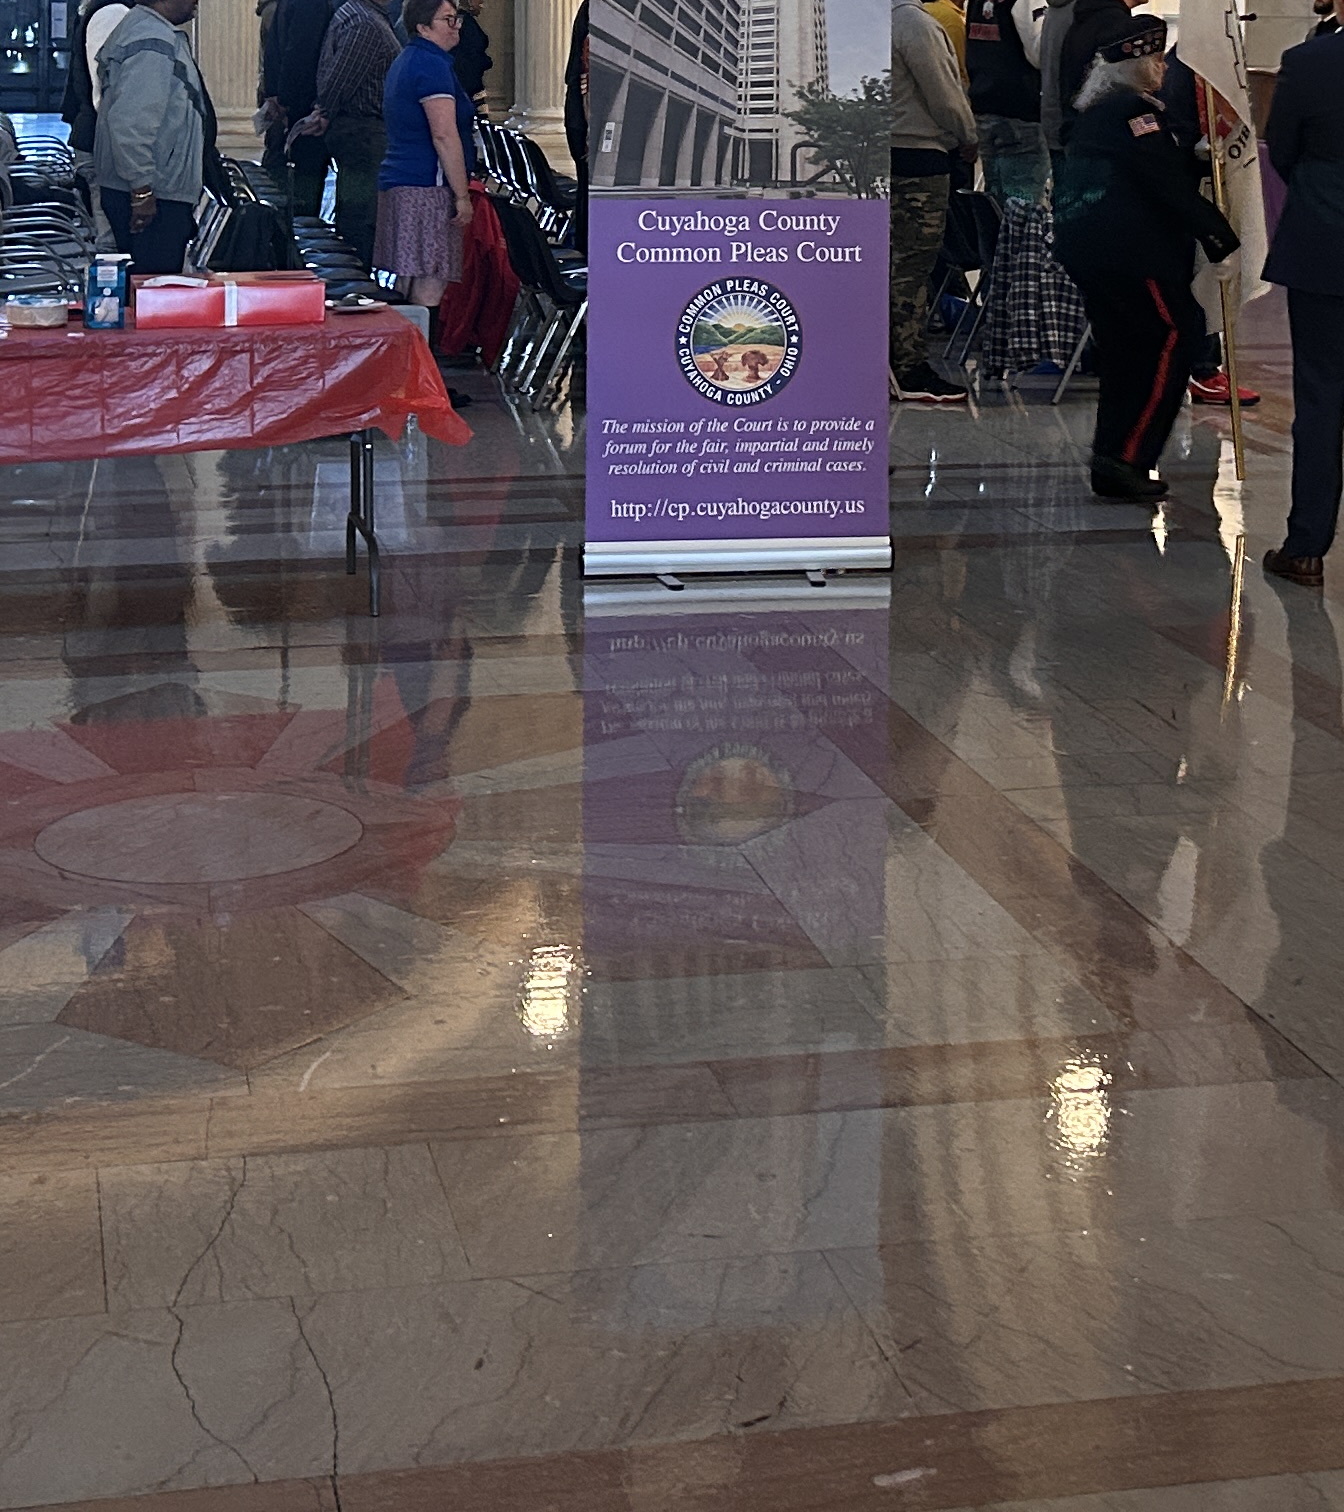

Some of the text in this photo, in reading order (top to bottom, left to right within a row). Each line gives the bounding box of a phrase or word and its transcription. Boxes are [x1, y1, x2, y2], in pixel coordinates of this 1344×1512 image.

[638, 210, 840, 236] Cuyahoga County
[616, 241, 862, 263] Common Pleas Court
[678, 279, 799, 333] COMMON PLEAS COURT
[678, 348, 722, 402] CUYAHOGA
[726, 383, 773, 405] COUNTY
[779, 347, 799, 377] OHIO
[602, 417, 875, 436] The mission of the Court is to provide a
[601, 437, 874, 458] forum for the fair, impartial and timely
[608, 457, 867, 477] resolution of civil and criminal cases.
[610, 497, 865, 522] http://cp.cuyahogacounty.us
